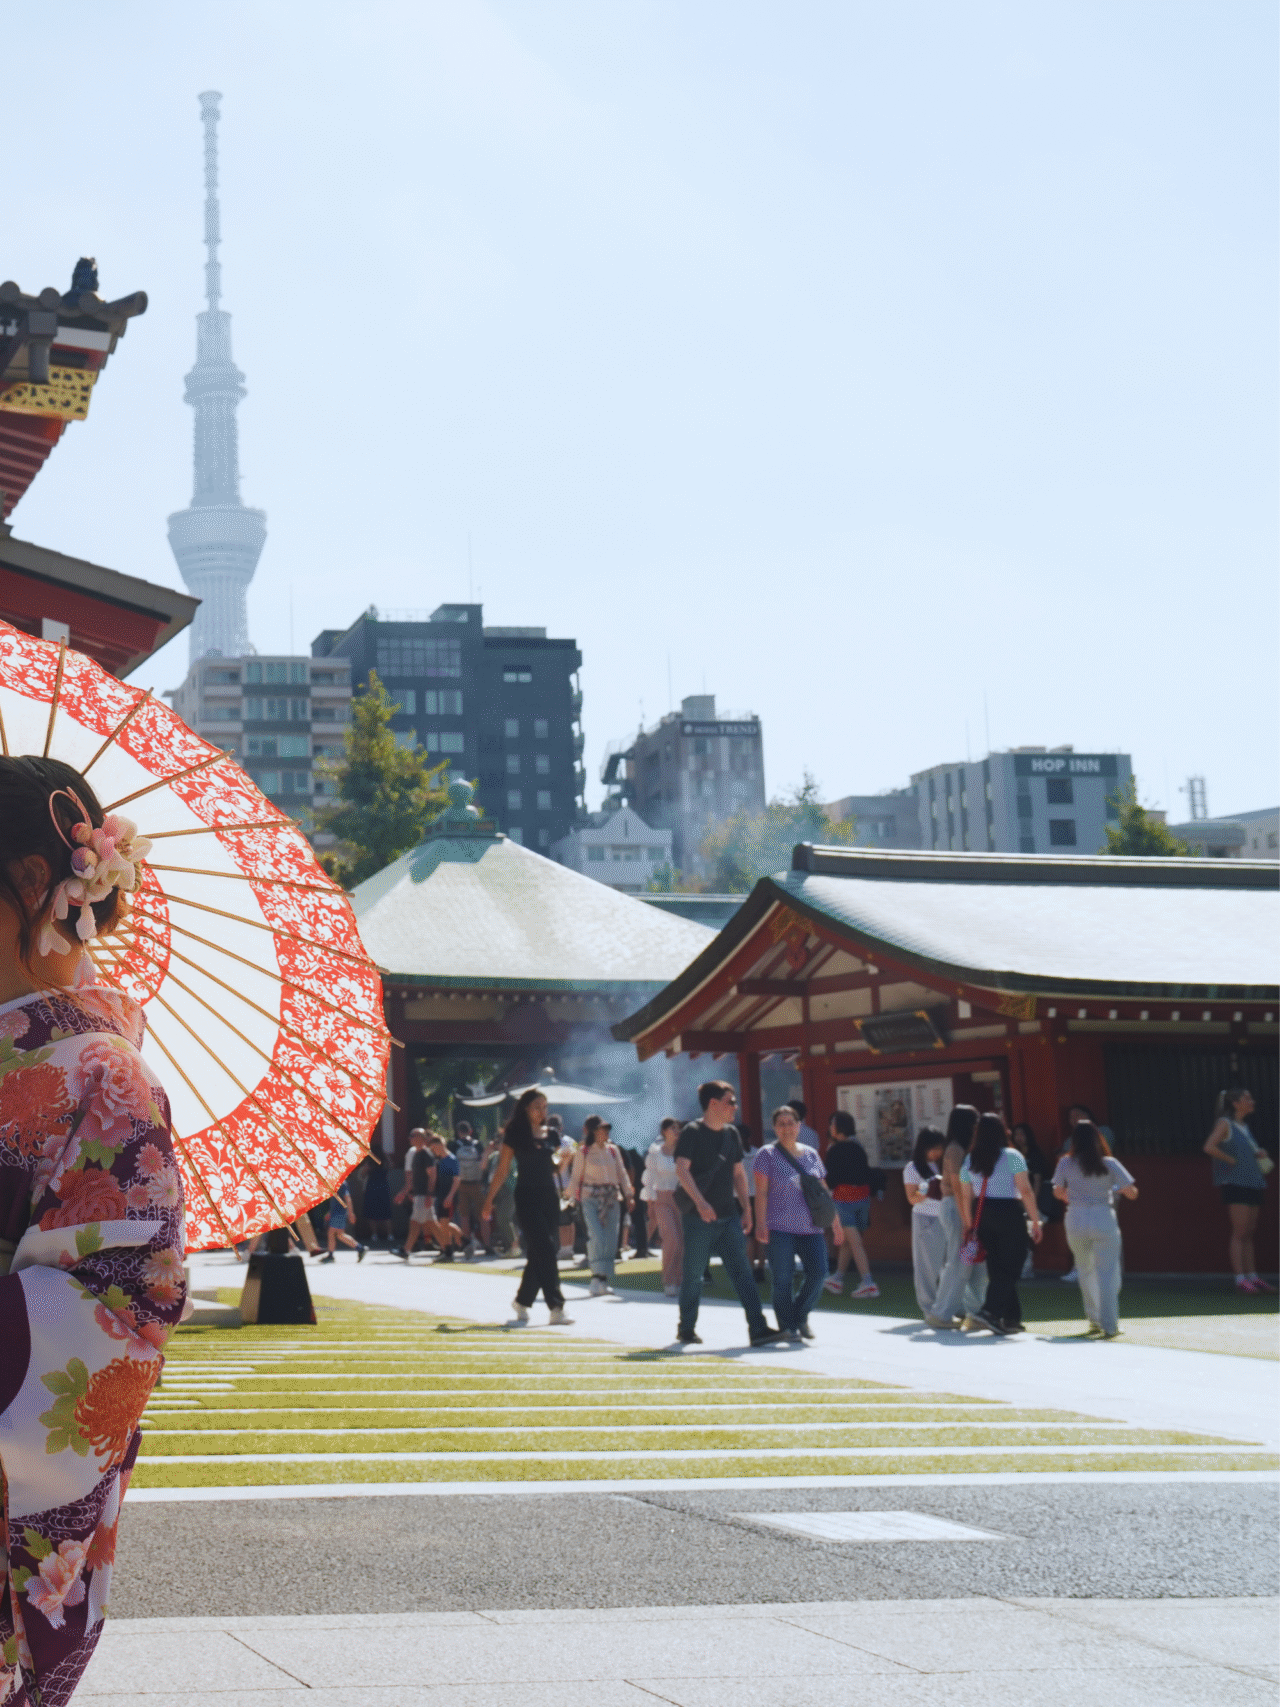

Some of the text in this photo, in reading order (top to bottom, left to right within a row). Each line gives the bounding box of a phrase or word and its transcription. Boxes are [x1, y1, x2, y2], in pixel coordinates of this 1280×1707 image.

[720, 725, 757, 734] TREND
[1032, 759, 1100, 772] HOP INN
